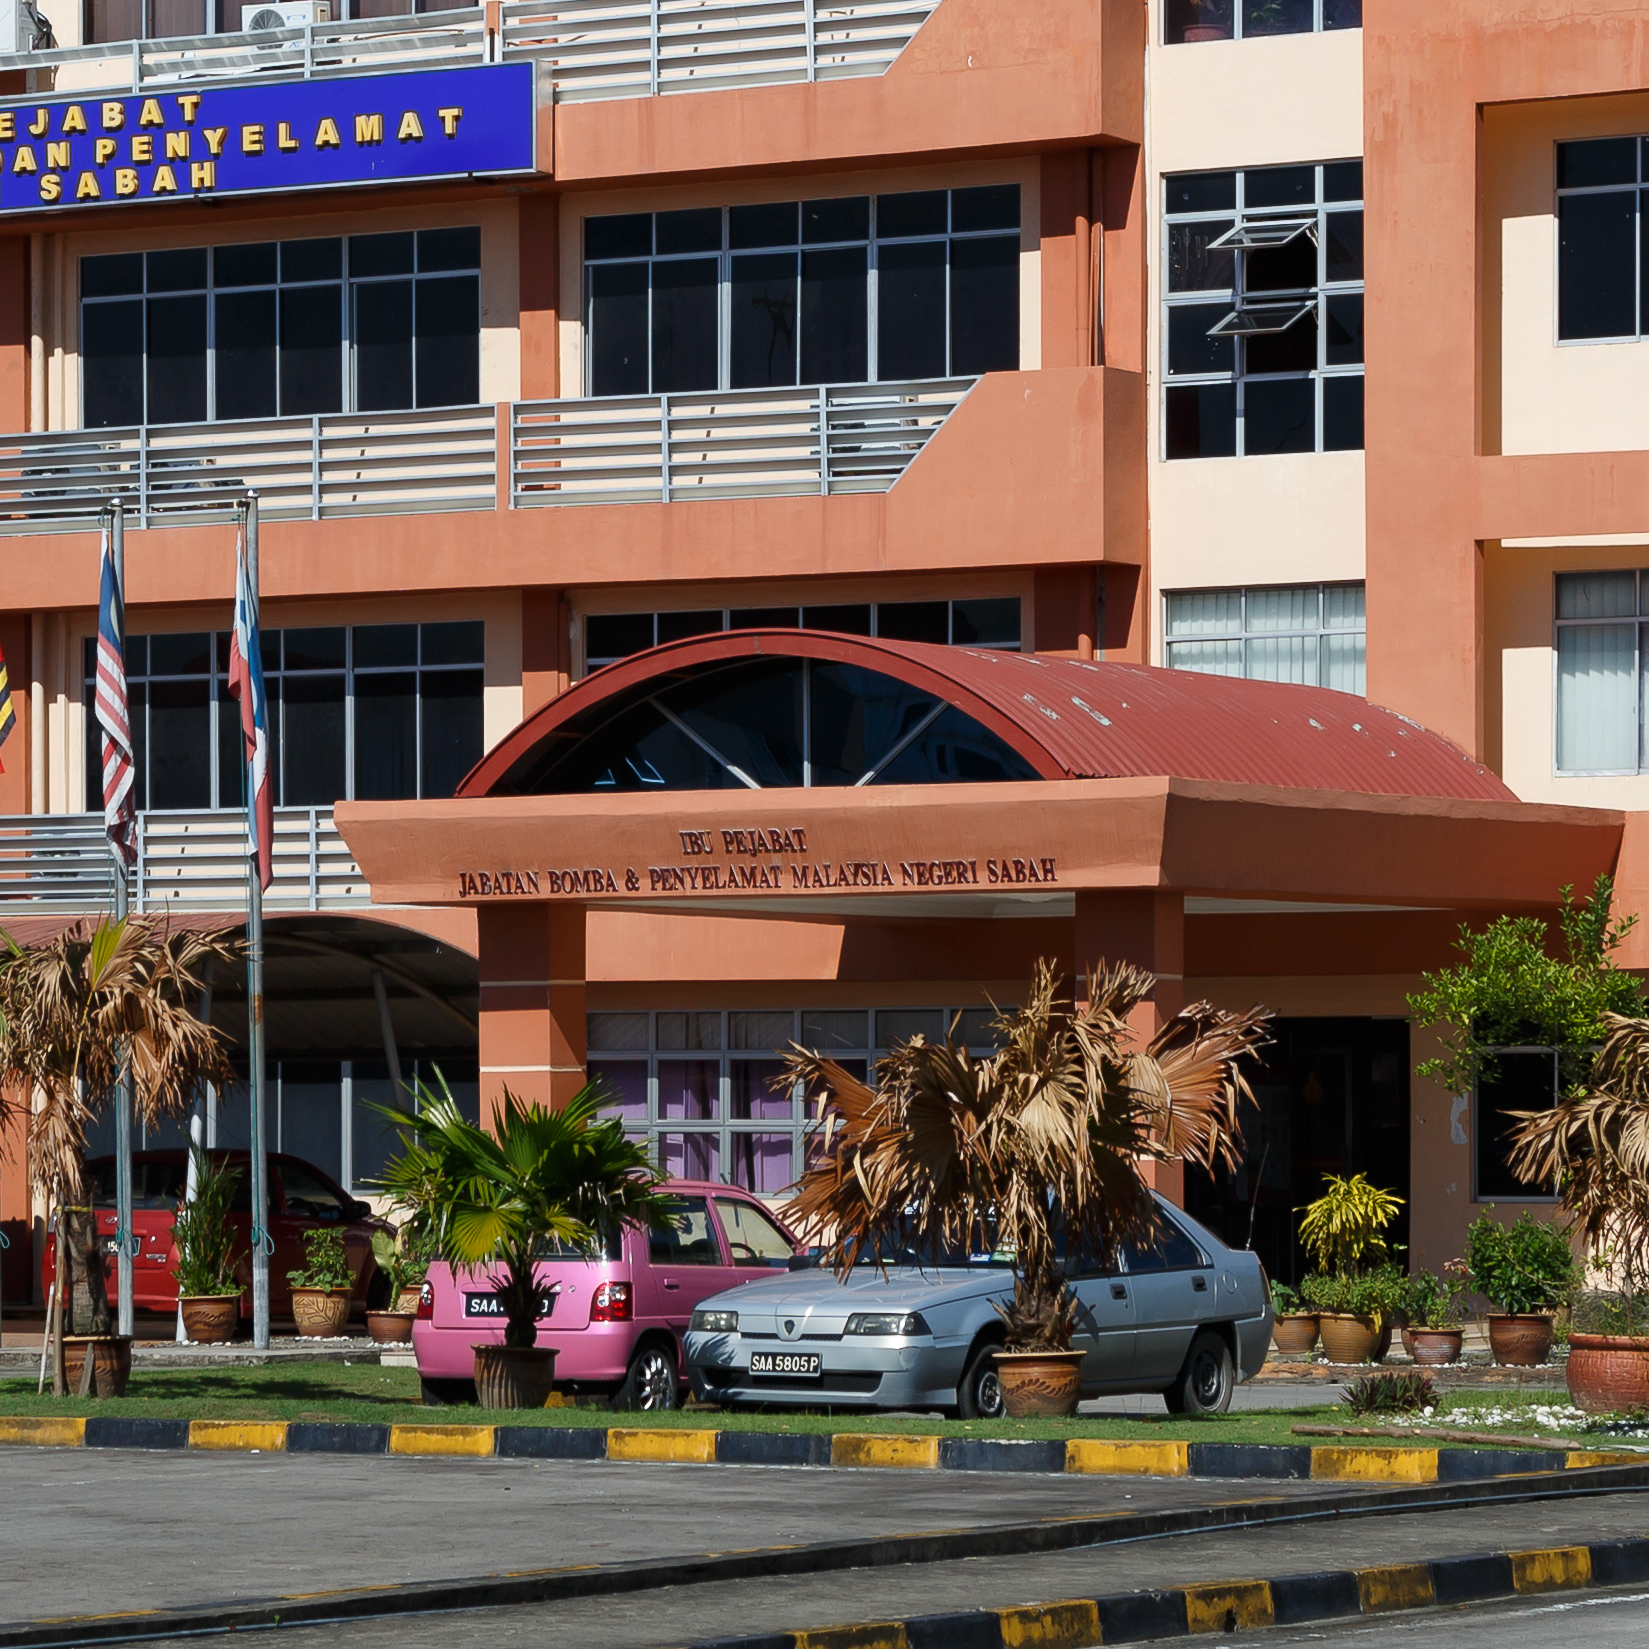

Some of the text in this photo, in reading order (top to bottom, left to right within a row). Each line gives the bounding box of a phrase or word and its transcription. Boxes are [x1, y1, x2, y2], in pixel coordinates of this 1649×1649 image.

[95, 107, 462, 165] PENYELAMAT
[39, 161, 216, 201] SABAH
[679, 827, 808, 857] IBU PEJABAT
[459, 857, 1058, 898] JABATAN BOMBA & PENYELAMAT MALAYSIA NEGERI SABAH
[470, 1298, 498, 1313] SAA
[752, 1355, 819, 1372] SAA 5805 P
